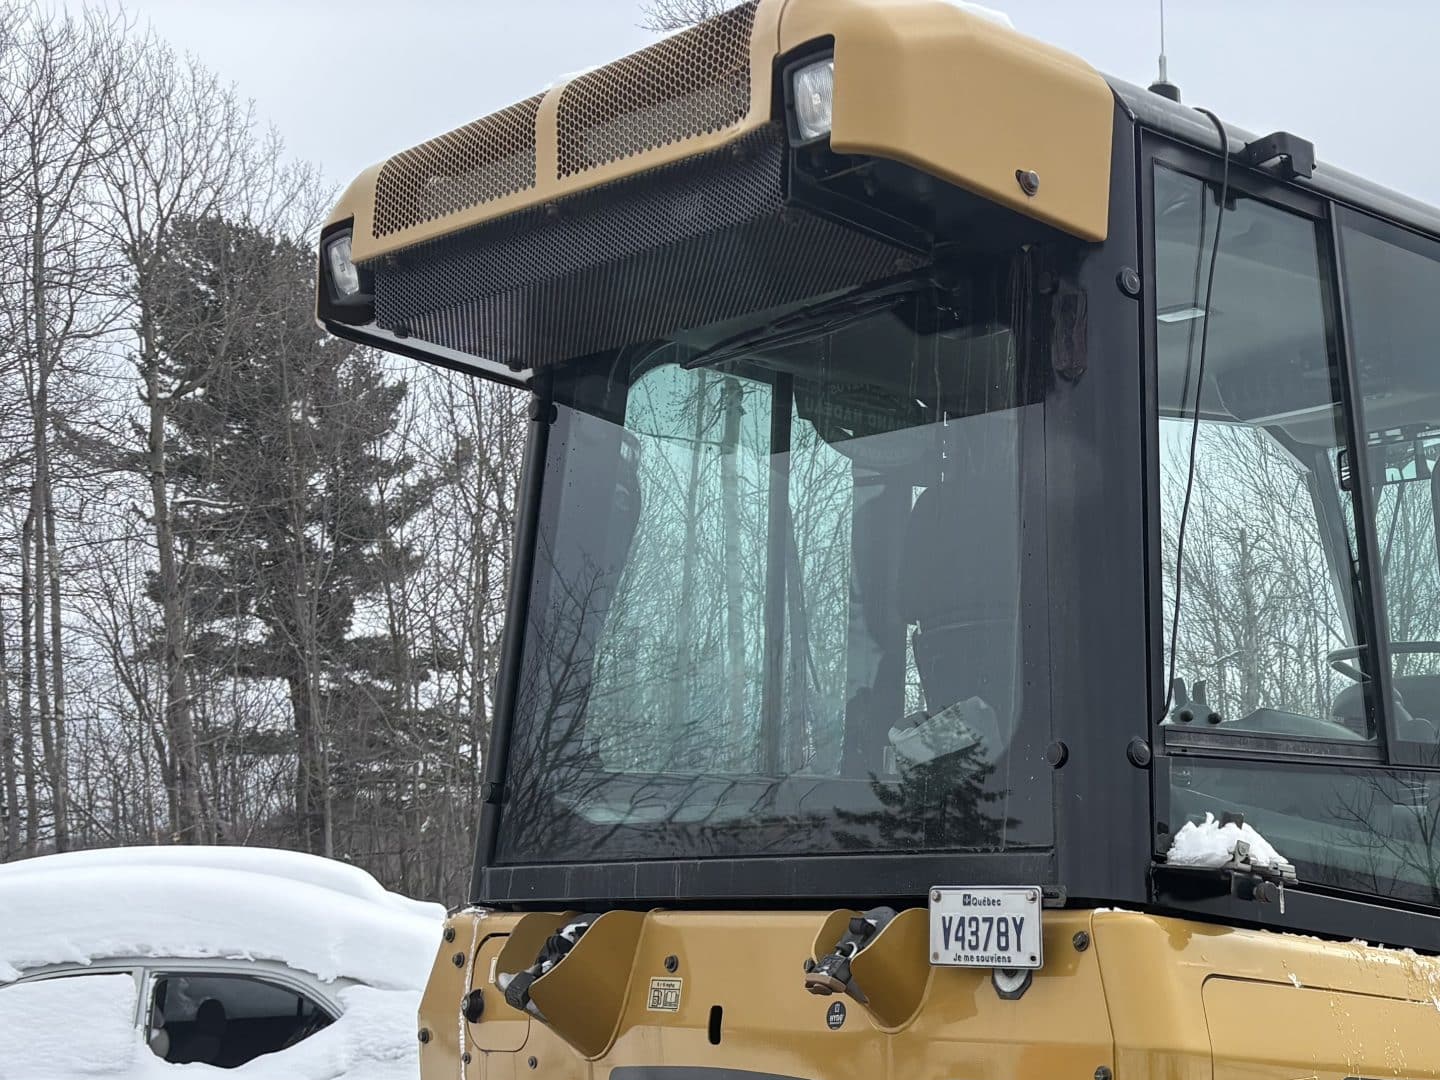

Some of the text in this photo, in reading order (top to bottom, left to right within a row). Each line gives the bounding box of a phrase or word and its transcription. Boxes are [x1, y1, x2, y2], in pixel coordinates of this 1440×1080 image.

[971, 896, 1002, 907] Québec
[941, 915, 1025, 953] V4378Y
[953, 952, 1012, 964] Je me souviens
